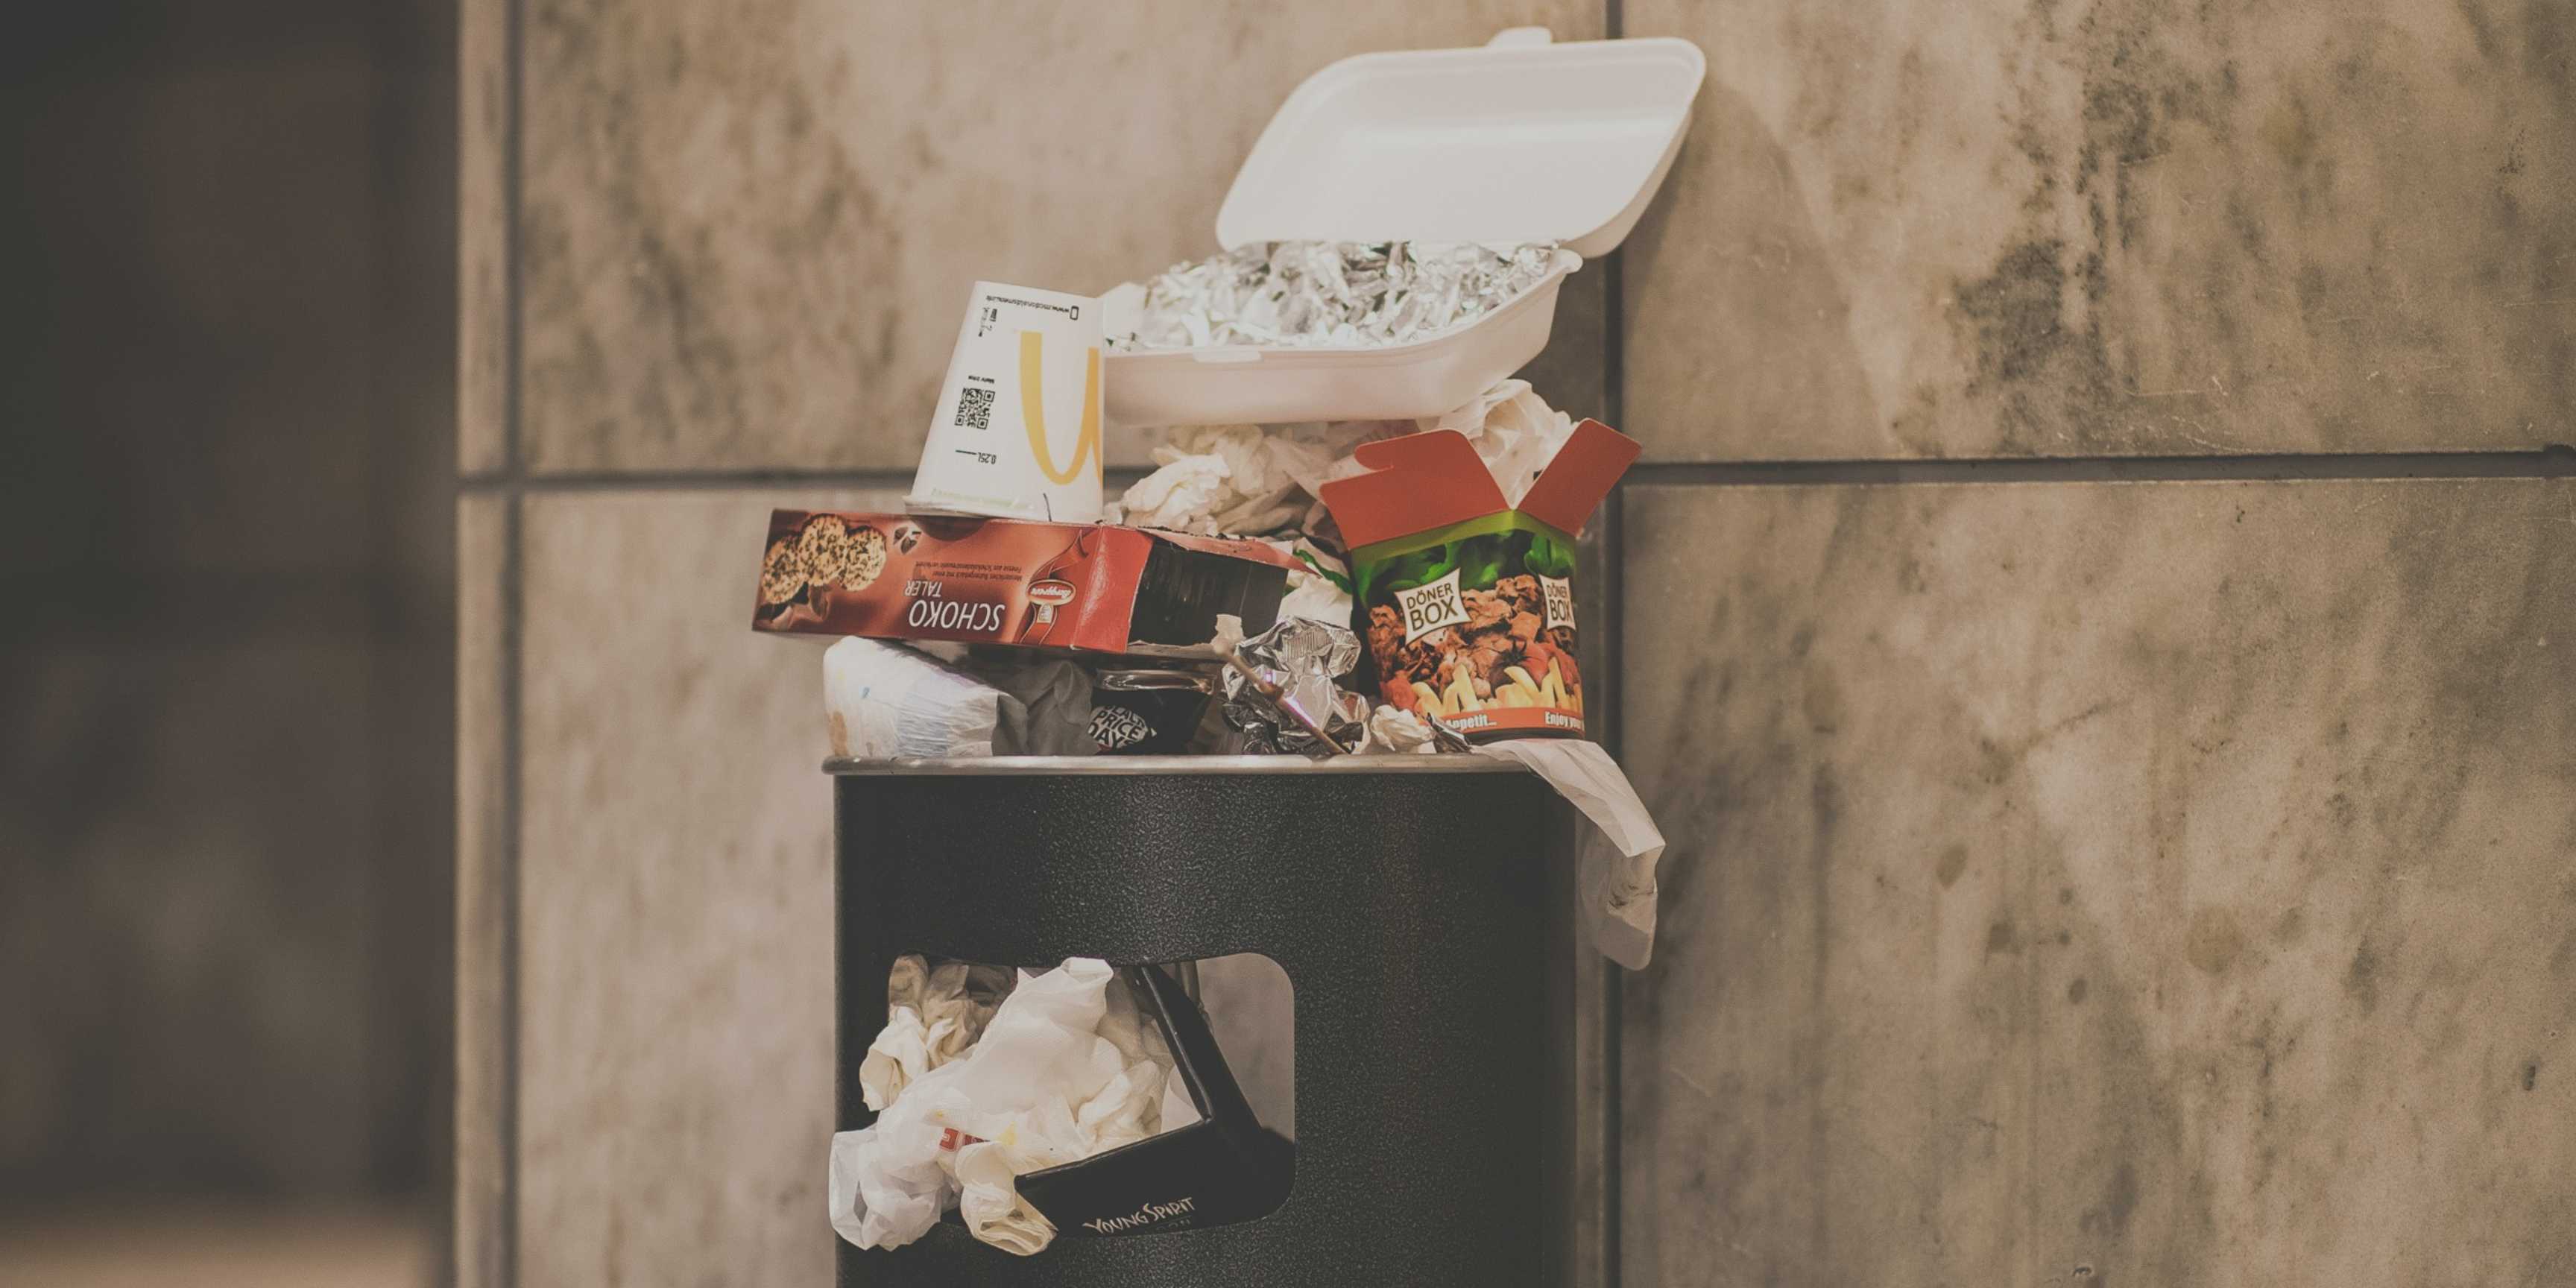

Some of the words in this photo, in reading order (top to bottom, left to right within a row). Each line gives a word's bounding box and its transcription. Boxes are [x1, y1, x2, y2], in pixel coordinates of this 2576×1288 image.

[904, 580, 942, 597] TALER
[1406, 582, 1453, 610] DÖNER
[909, 599, 1006, 631] SCHOKO
[1409, 596, 1459, 631] BOX
[1549, 599, 1573, 622] BOX
[1092, 709, 1143, 741] PRICE
[1545, 710, 1568, 728] Enjoy
[1082, 1211, 1149, 1234] YOUNG
